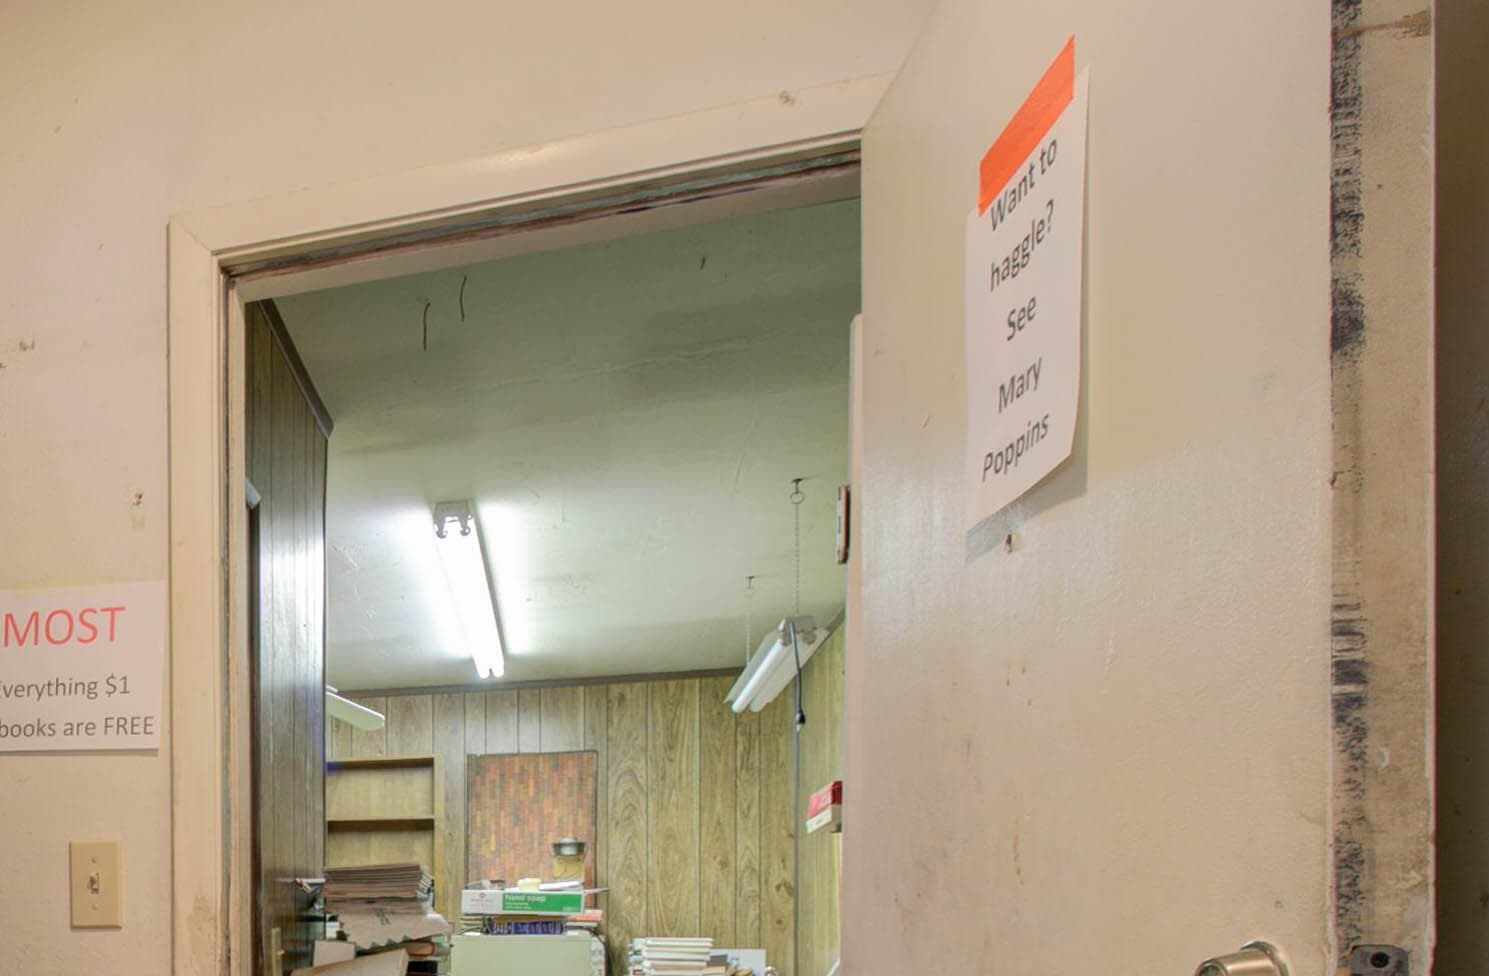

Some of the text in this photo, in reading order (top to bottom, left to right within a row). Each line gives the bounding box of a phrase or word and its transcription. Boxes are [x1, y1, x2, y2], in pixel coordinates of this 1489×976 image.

[989, 138, 1058, 233] Want to
[989, 199, 1055, 293] haggle?
[1006, 296, 1037, 342] See
[998, 356, 1043, 414] Mary
[981, 413, 1050, 483] Poppins
[2, 606, 126, 647] MOST
[104, 672, 131, 698] $1
[62, 720, 97, 737] are
[103, 715, 155, 736] FREE
